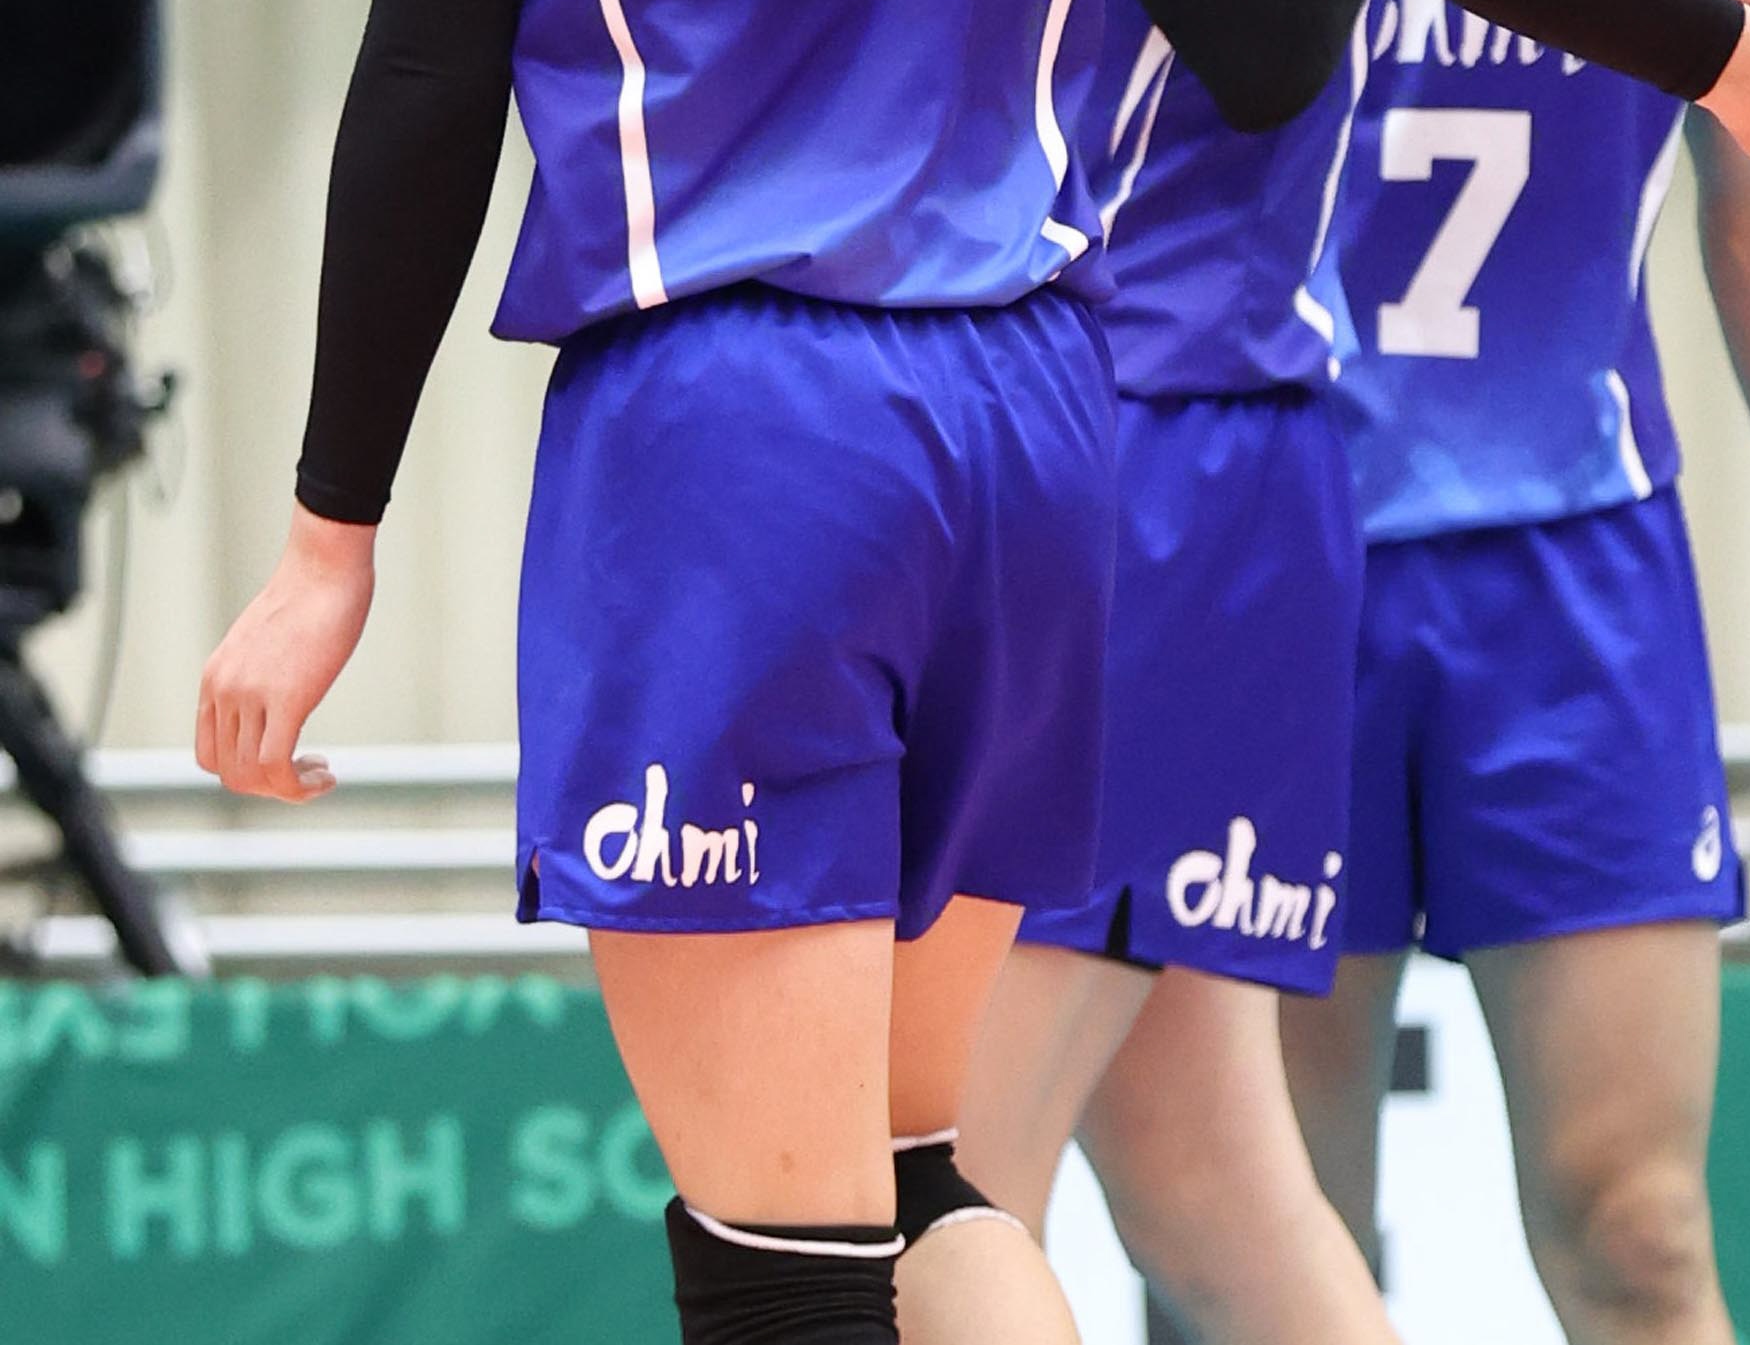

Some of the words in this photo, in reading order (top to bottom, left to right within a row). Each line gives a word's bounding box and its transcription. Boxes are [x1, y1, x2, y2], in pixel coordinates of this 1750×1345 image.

[1377, 110, 1532, 359] 7
[583, 763, 760, 887] ohmi
[1166, 816, 1343, 950] ohmi
[104, 1114, 469, 1261] HIGH
